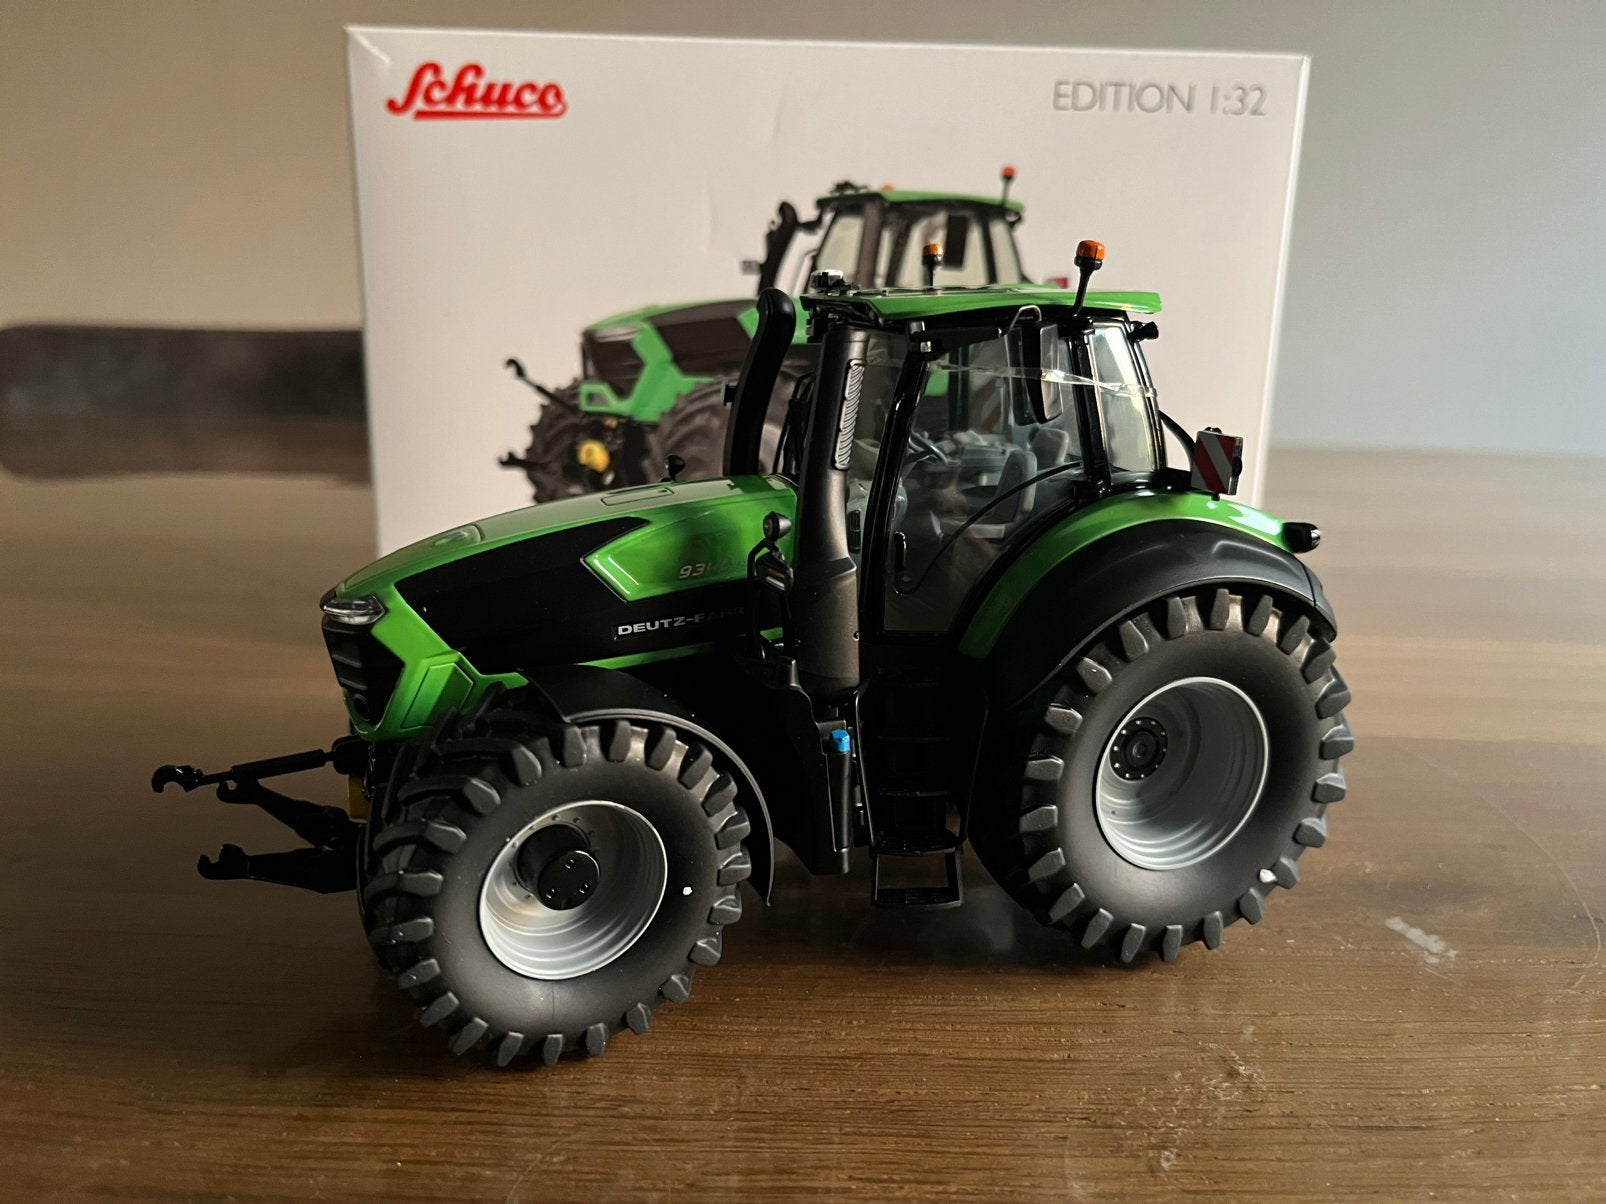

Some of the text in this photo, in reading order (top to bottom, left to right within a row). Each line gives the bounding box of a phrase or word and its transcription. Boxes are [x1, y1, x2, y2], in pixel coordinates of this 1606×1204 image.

[386, 61, 568, 121] Schuco
[1052, 79, 1197, 114] EDITION
[617, 606, 745, 636] DEUTZ-FAHR
